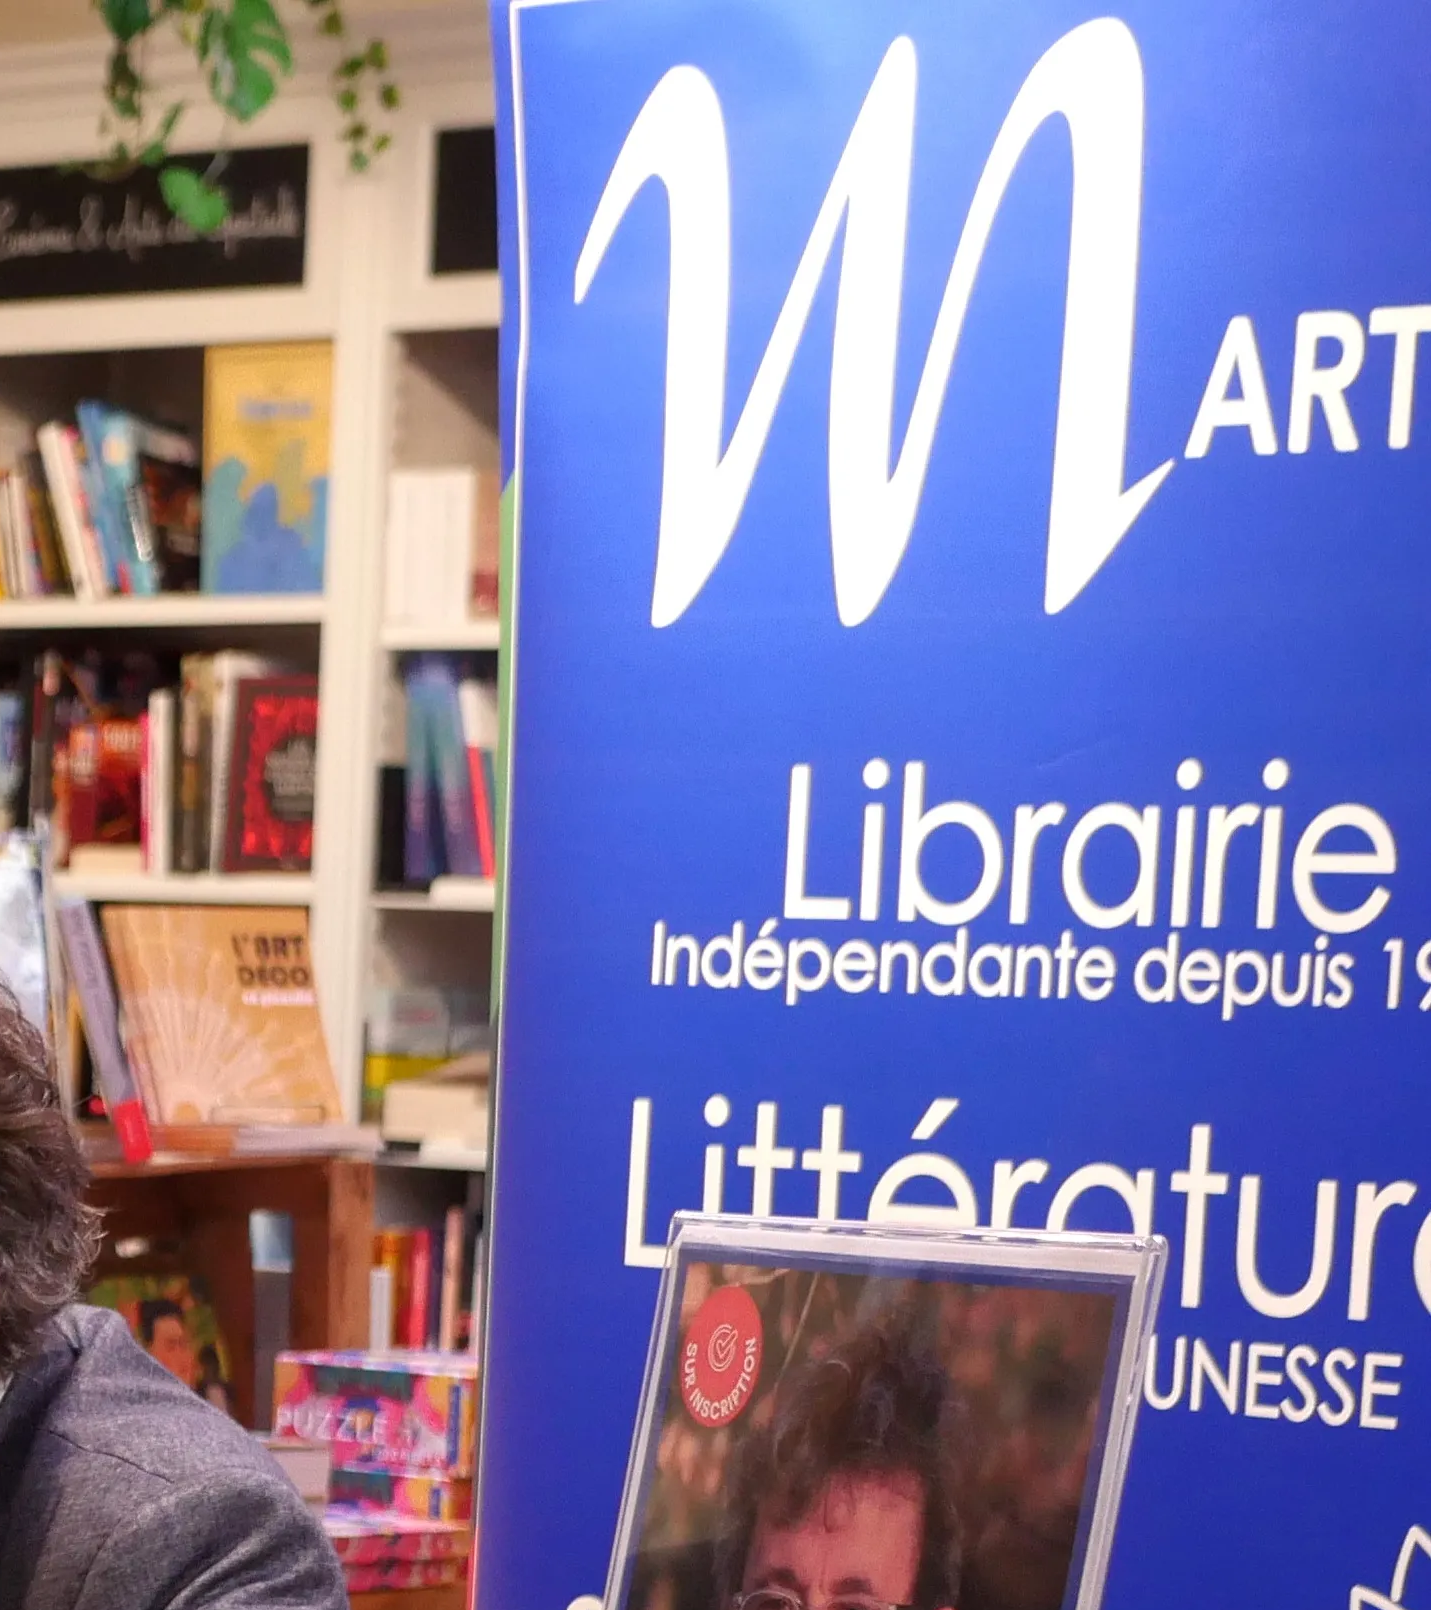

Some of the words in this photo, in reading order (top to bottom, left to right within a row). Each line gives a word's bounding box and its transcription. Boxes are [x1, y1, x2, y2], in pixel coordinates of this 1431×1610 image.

[783, 758, 1397, 935] Librairie
[650, 917, 1117, 1006] Indépendante
[1134, 931, 1356, 1022] depuis
[684, 1341, 699, 1388] SUR
[690, 1337, 757, 1420] INSCRIPTION
[1142, 1332, 1405, 1431] UNESSE
